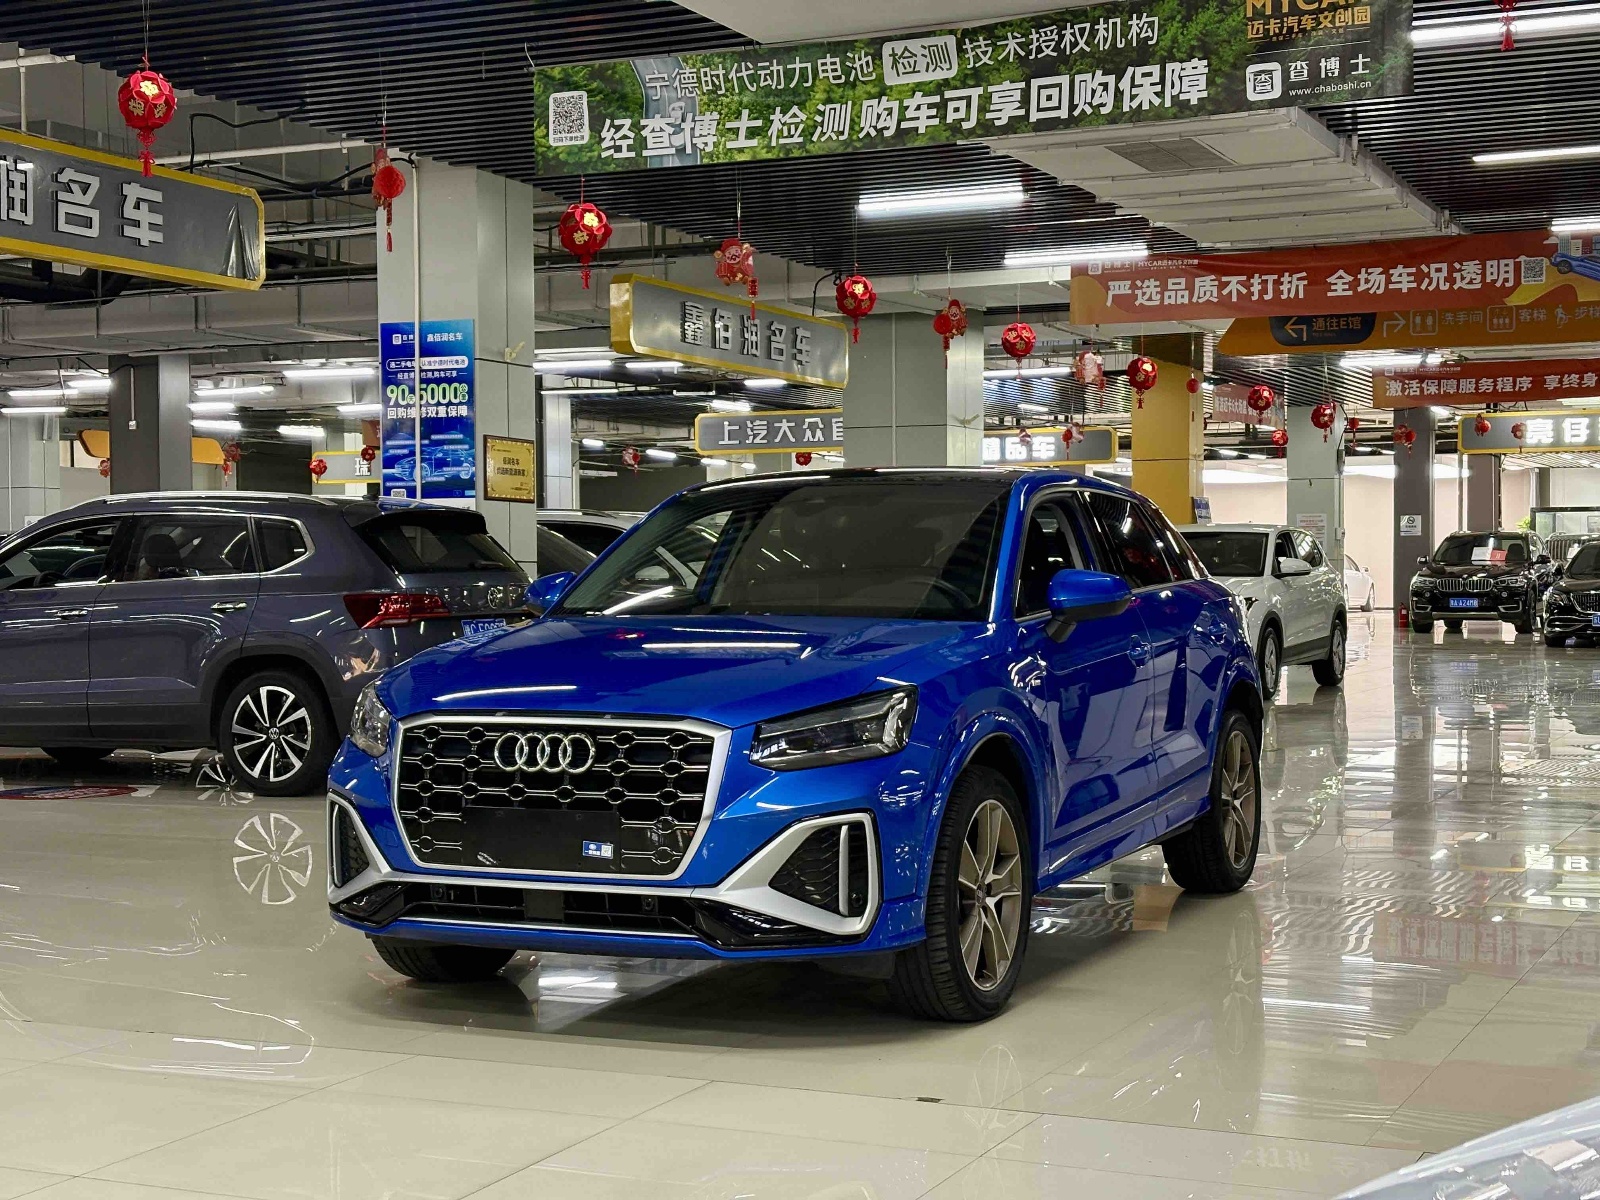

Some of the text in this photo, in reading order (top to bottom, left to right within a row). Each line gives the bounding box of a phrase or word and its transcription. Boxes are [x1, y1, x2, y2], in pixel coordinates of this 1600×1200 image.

[1247, 6, 1371, 39] 迈卡汽车文创园
[644, 13, 1160, 101] 宁德时代动力电池 检测 技术授权机构
[1288, 53, 1371, 82] 查博士
[1288, 80, 1372, 96] www.chaboshi.cn
[1106, 258, 1515, 308] 严选品质不打折 全场车况透明
[1311, 316, 1362, 331] 通往E馆
[1441, 311, 1483, 325] 洗手间
[1518, 308, 1547, 322] 客梯
[682, 301, 811, 367] 鑫佰润名车
[1386, 372, 1599, 397] 激活保障服务程序 享终身
